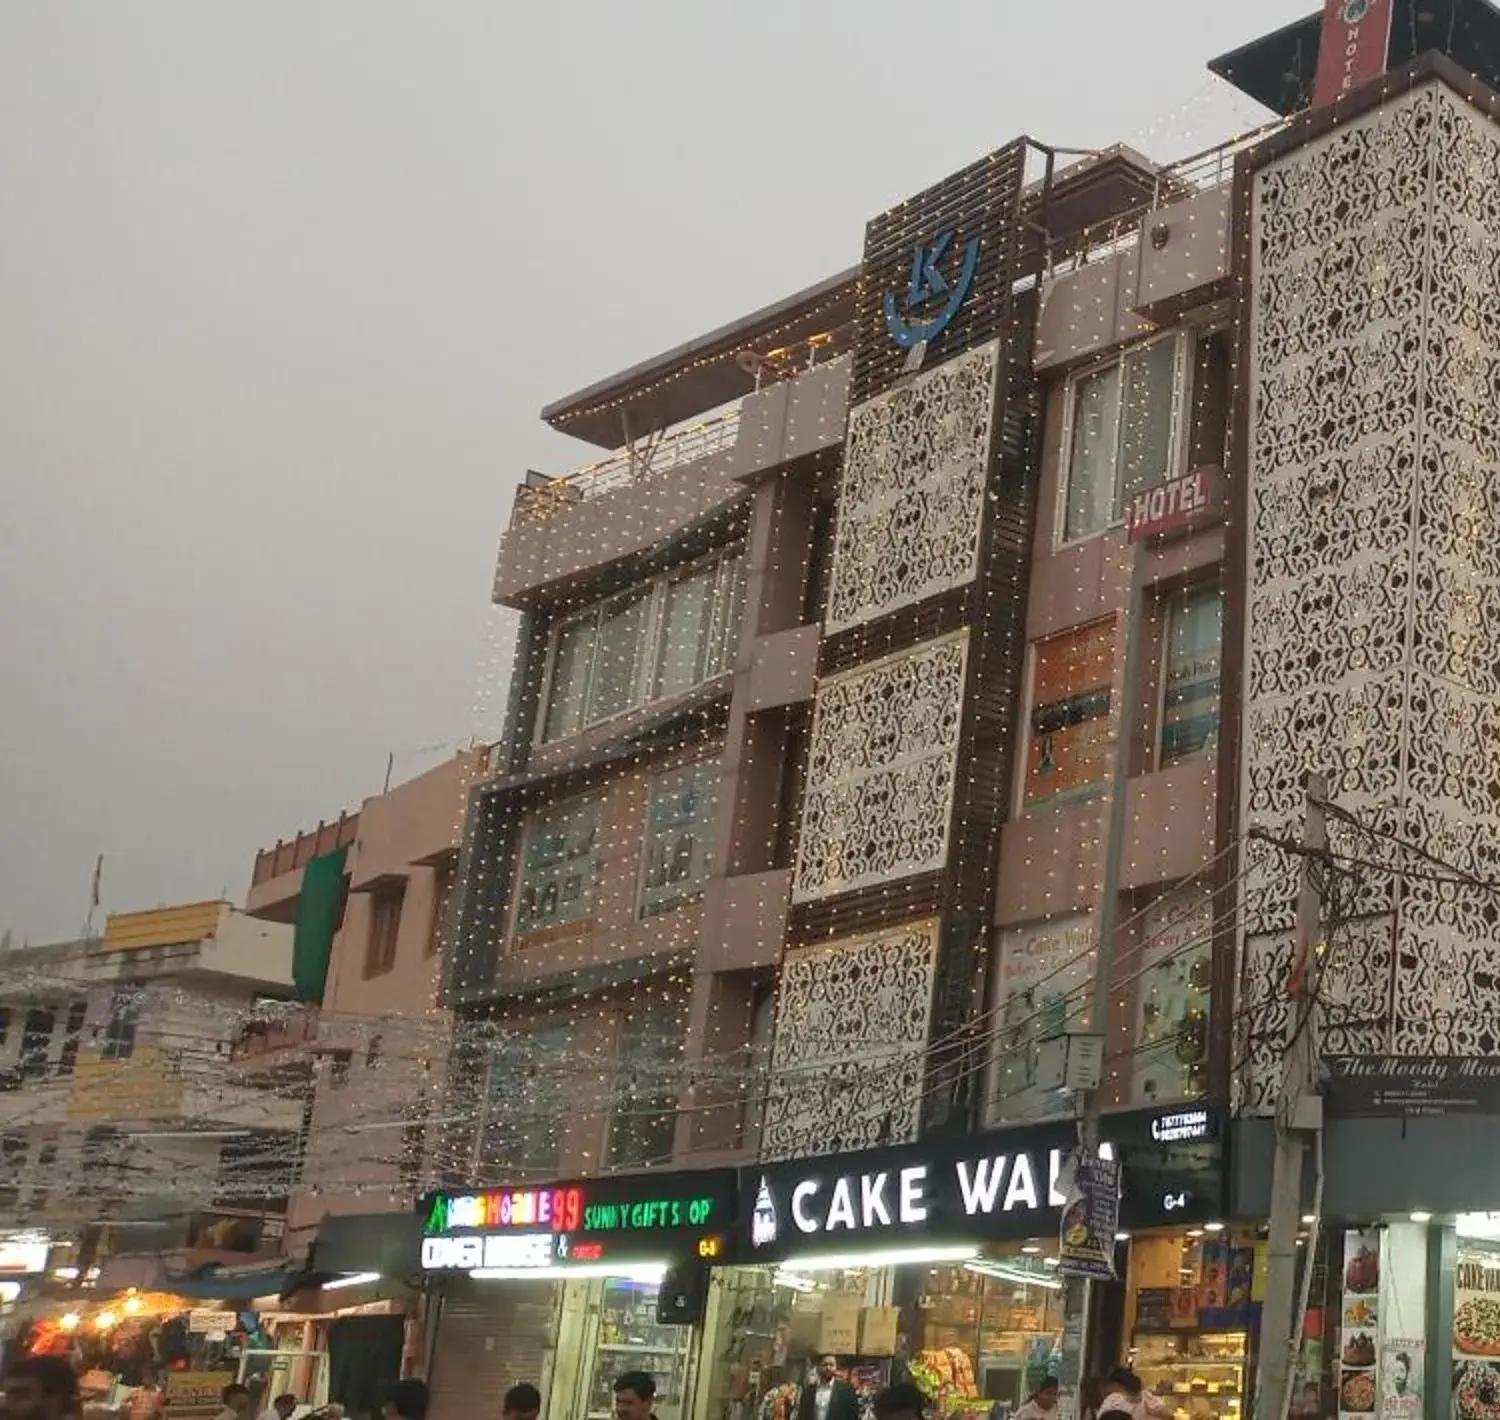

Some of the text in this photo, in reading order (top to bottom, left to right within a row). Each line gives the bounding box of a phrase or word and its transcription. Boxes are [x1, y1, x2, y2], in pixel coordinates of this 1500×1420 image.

[1134, 471, 1205, 526] HOTEL
[1376, 1058, 1449, 1080] Moody
[553, 1188, 581, 1231] 99
[791, 1166, 927, 1233] CAKE
[1163, 1193, 1185, 1210] G-4
